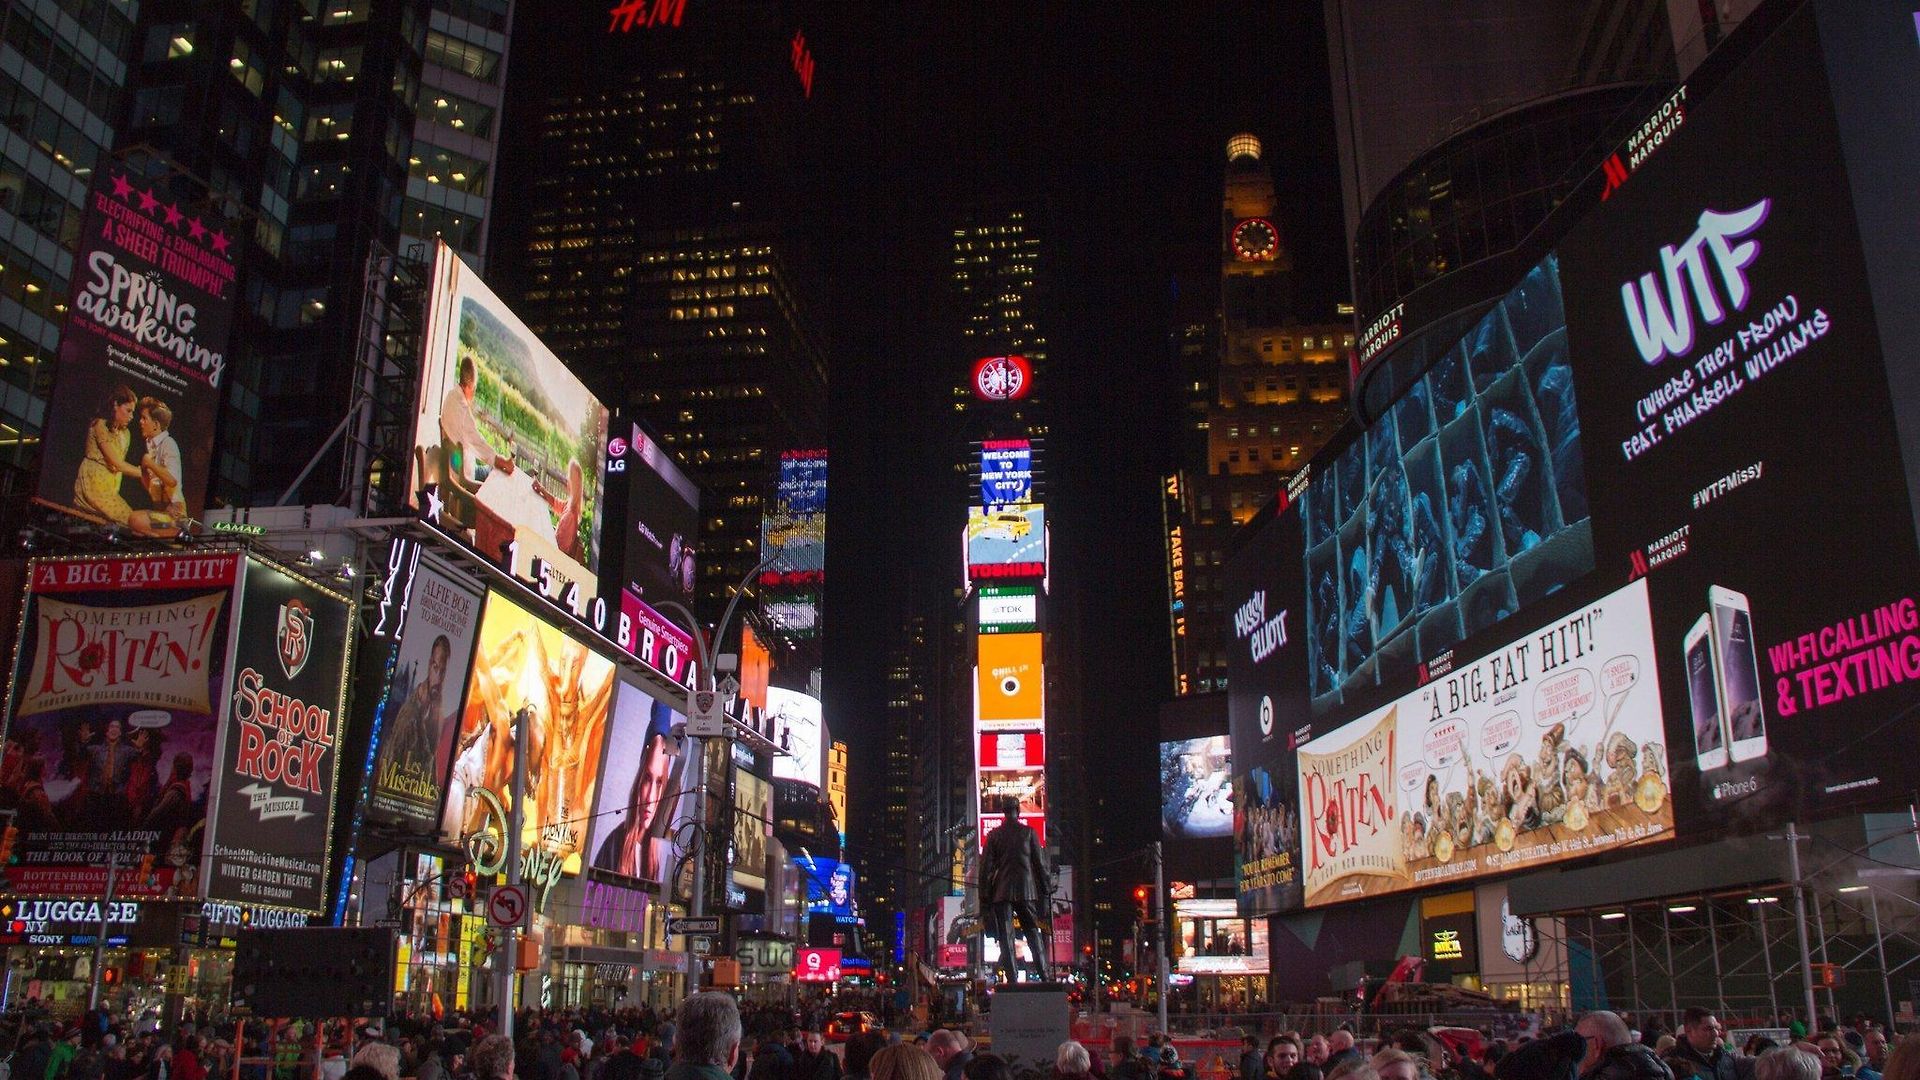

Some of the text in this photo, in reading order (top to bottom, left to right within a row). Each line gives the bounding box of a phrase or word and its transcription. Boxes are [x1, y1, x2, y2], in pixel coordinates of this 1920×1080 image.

[1626, 85, 1687, 153] MARRIOTT
[1629, 110, 1685, 169] MARQUIS
[115, 222, 158, 264] SHEER
[86, 250, 197, 334] SPRING
[1621, 196, 1772, 366] WTF
[77, 290, 226, 389] awakening
[1358, 302, 1405, 350] MARRIOTT
[1359, 323, 1401, 366] MARQUIS
[1744, 308, 1831, 381] WILLIAMS
[1695, 338, 1735, 379] THEY
[982, 440, 1030, 449] TOSHIBA
[982, 451, 1030, 460] WELCOME
[608, 459, 625, 472] LG
[981, 470, 1032, 480] NEW YORK
[999, 461, 1013, 469] TO
[1692, 460, 1763, 510] #WTFMissy
[215, 523, 262, 535] LAMAR
[1647, 524, 1690, 555] MARRIOTT
[1649, 541, 1687, 567] MARQUIS
[119, 561, 168, 583] FAT
[969, 562, 1044, 579] TOSHIBA
[61, 604, 197, 628] SOMETHING
[638, 608, 661, 637] Genuine
[1001, 605, 1022, 613] TDK
[1234, 590, 1266, 639] MISSY
[1250, 609, 1289, 664] ELLIOTT
[1767, 597, 1919, 675] WI-FI CALLING
[1489, 640, 1530, 695] FAT
[1776, 634, 1920, 718] & TEXTING
[233, 667, 334, 747] SCHOOL
[277, 728, 294, 746] OF
[235, 720, 327, 795] ROCK
[1311, 729, 1384, 773] SOMETHING
[1721, 776, 1757, 799] iPhone 6
[263, 800, 300, 814] MUSICAL
[109, 830, 162, 842] ALADDIN
[26, 851, 49, 863] THE
[52, 851, 85, 863] BOOK
[221, 863, 313, 889] WINTER GARDEN THEATRE
[263, 886, 293, 900] BROADWAY
[15, 901, 139, 924] LUGGAGE
[201, 902, 309, 929] GIFTS LUGGAGE
[23, 921, 47, 933] NY
[28, 934, 64, 945] SONY
